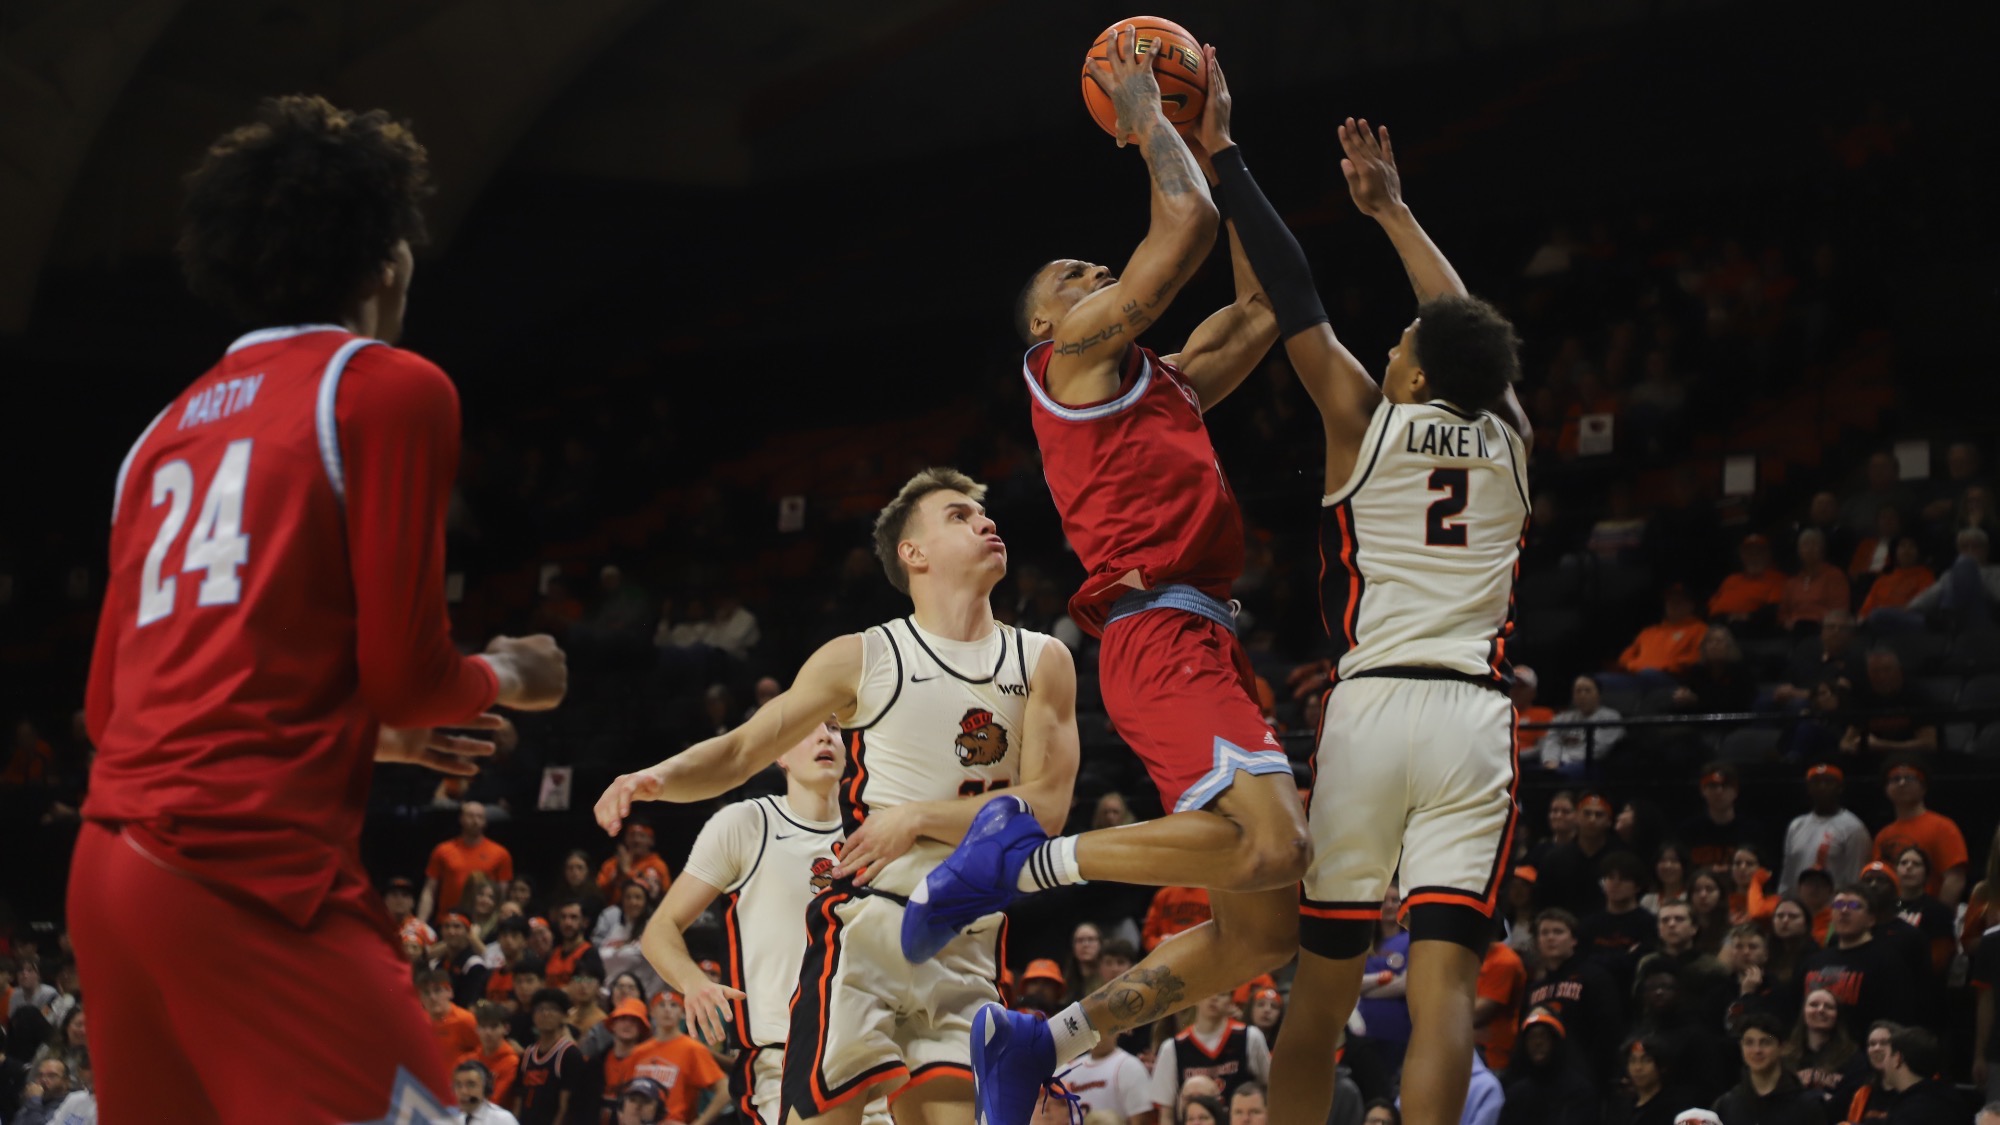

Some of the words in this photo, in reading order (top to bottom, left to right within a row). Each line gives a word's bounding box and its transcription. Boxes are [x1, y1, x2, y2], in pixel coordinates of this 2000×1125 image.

[177, 373, 265, 431] MARTIN
[1406, 421, 1470, 457] LAKE
[135, 437, 254, 629] 24
[1425, 467, 1468, 547] 2
[962, 711, 992, 732] OSU
